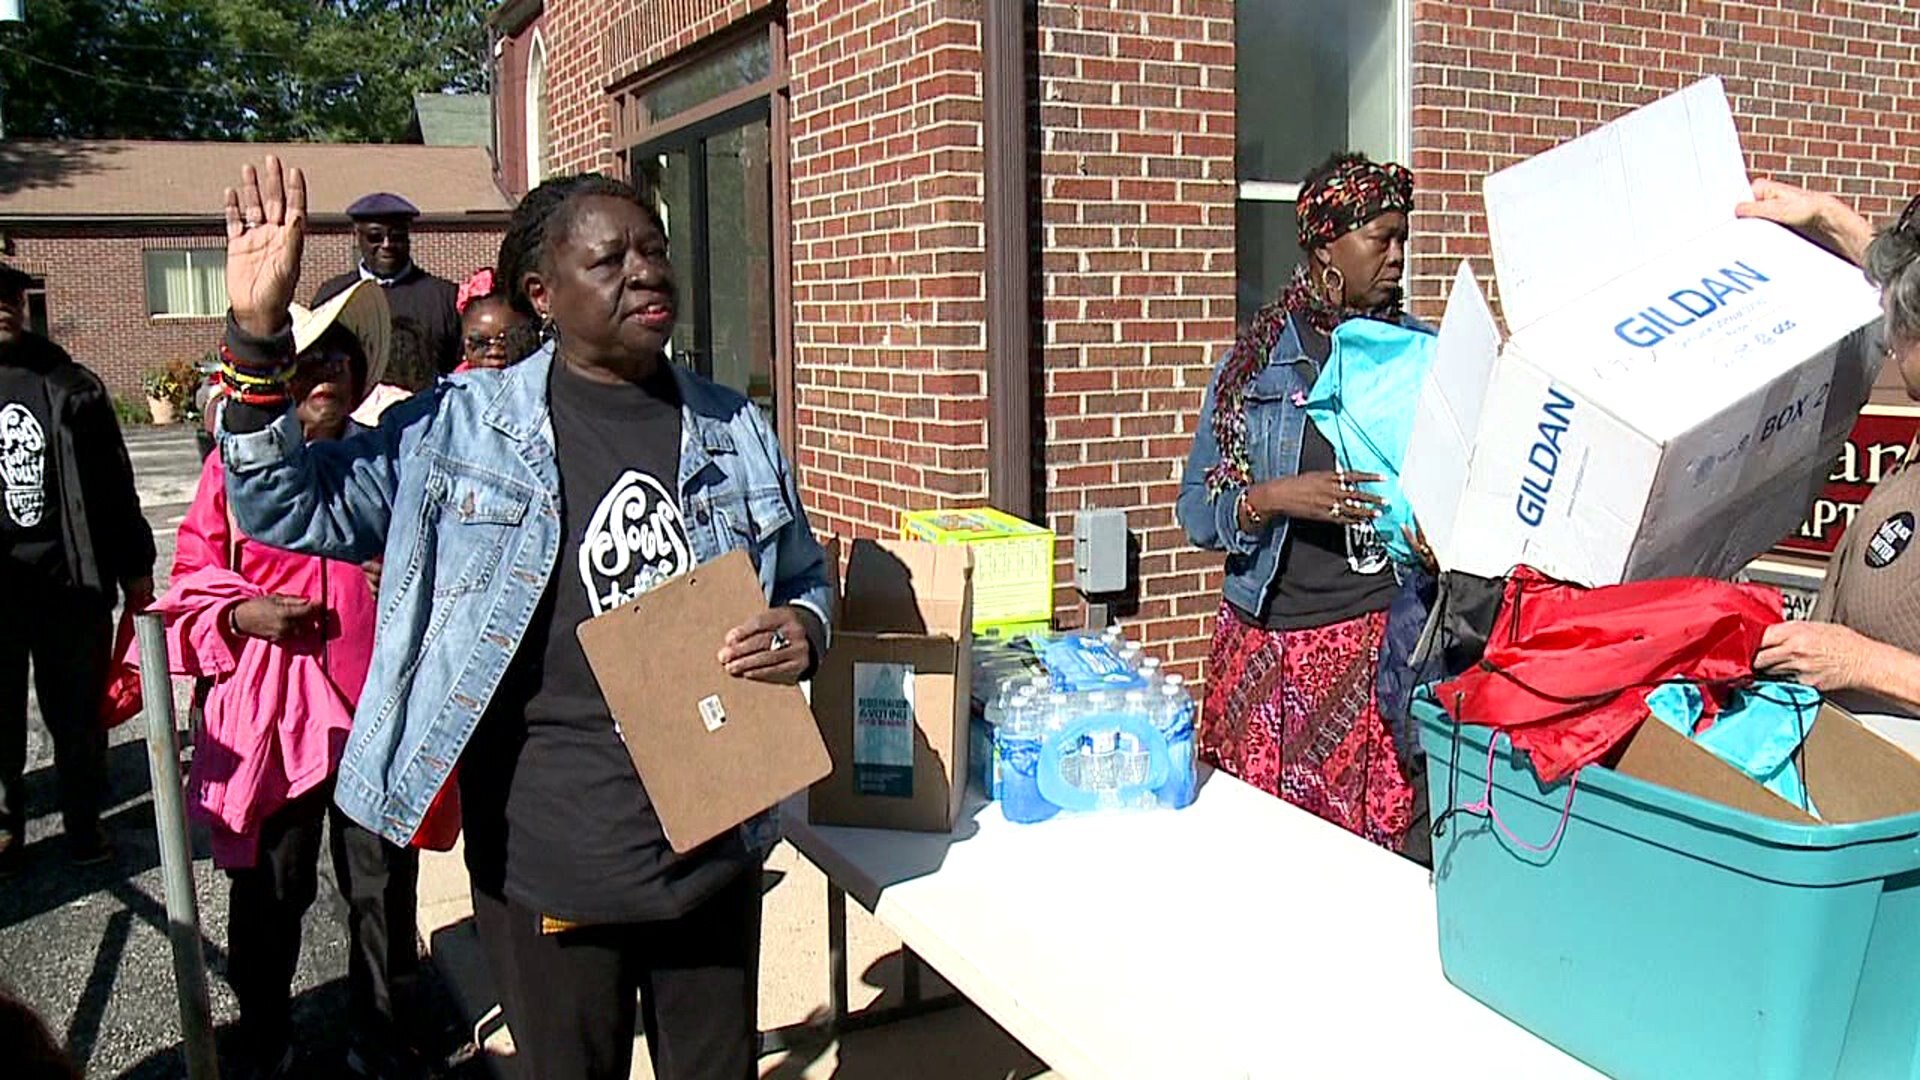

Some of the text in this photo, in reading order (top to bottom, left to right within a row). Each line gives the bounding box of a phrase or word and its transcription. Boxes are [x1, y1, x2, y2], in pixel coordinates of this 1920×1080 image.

[1614, 260, 1771, 348] GILDAN
[1516, 386, 1576, 527] GILDAN
[1760, 394, 1809, 442] BOX
